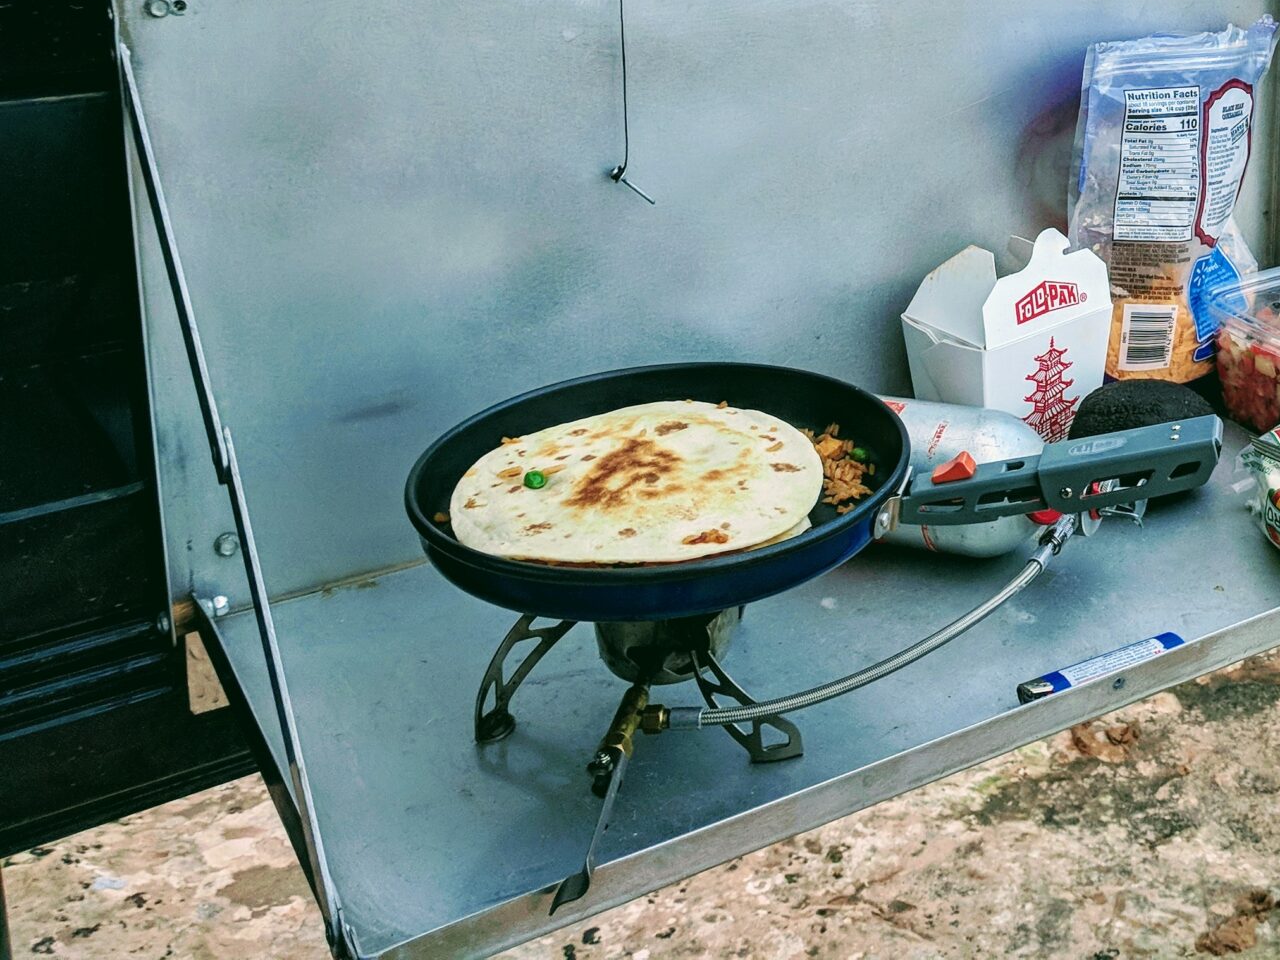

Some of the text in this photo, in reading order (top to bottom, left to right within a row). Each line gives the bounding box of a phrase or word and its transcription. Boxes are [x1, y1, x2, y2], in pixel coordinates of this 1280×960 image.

[1127, 90, 1198, 100] Nutrition Facts
[1180, 119, 1197, 129] 110
